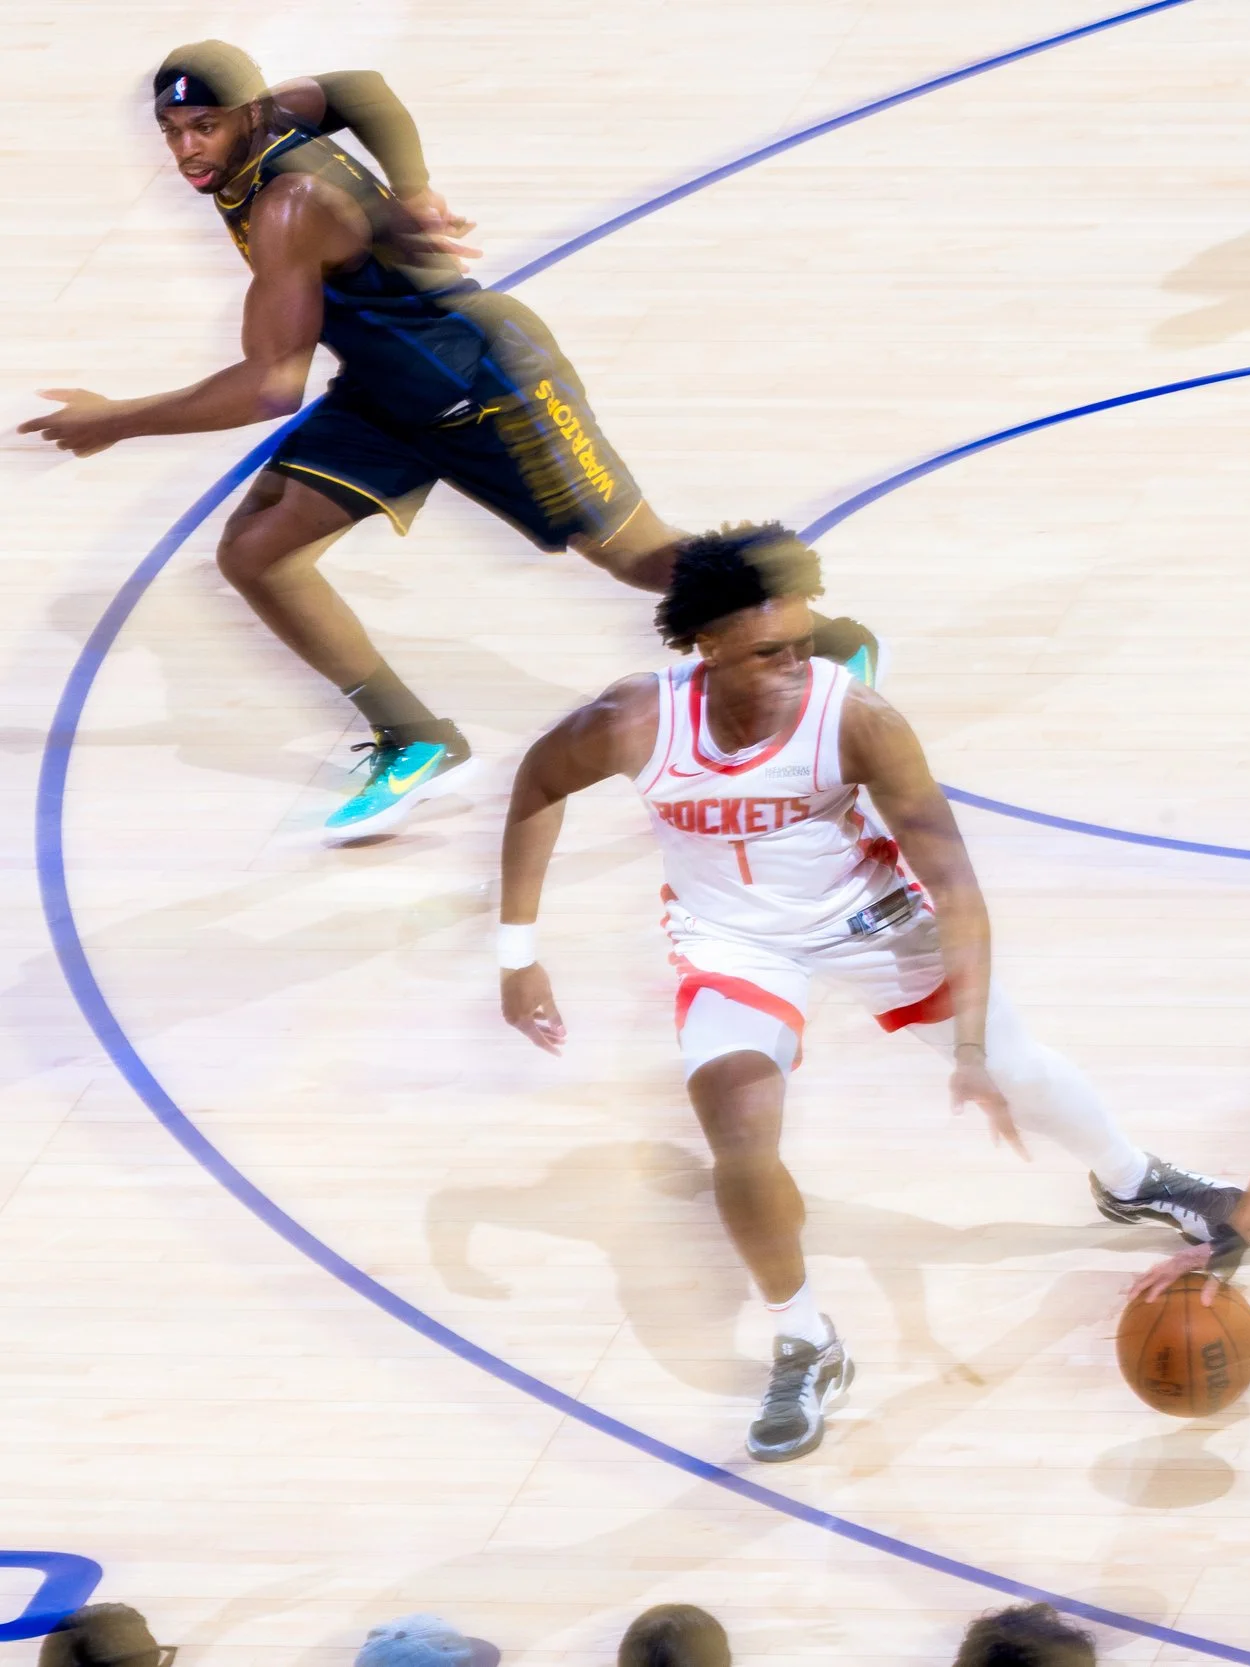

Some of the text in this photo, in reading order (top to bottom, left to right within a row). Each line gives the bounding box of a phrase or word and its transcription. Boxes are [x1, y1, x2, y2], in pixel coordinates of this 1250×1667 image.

[535, 380, 615, 503] WARRIORS
[652, 797, 811, 835] ROCKETS
[728, 840, 754, 885] 1
